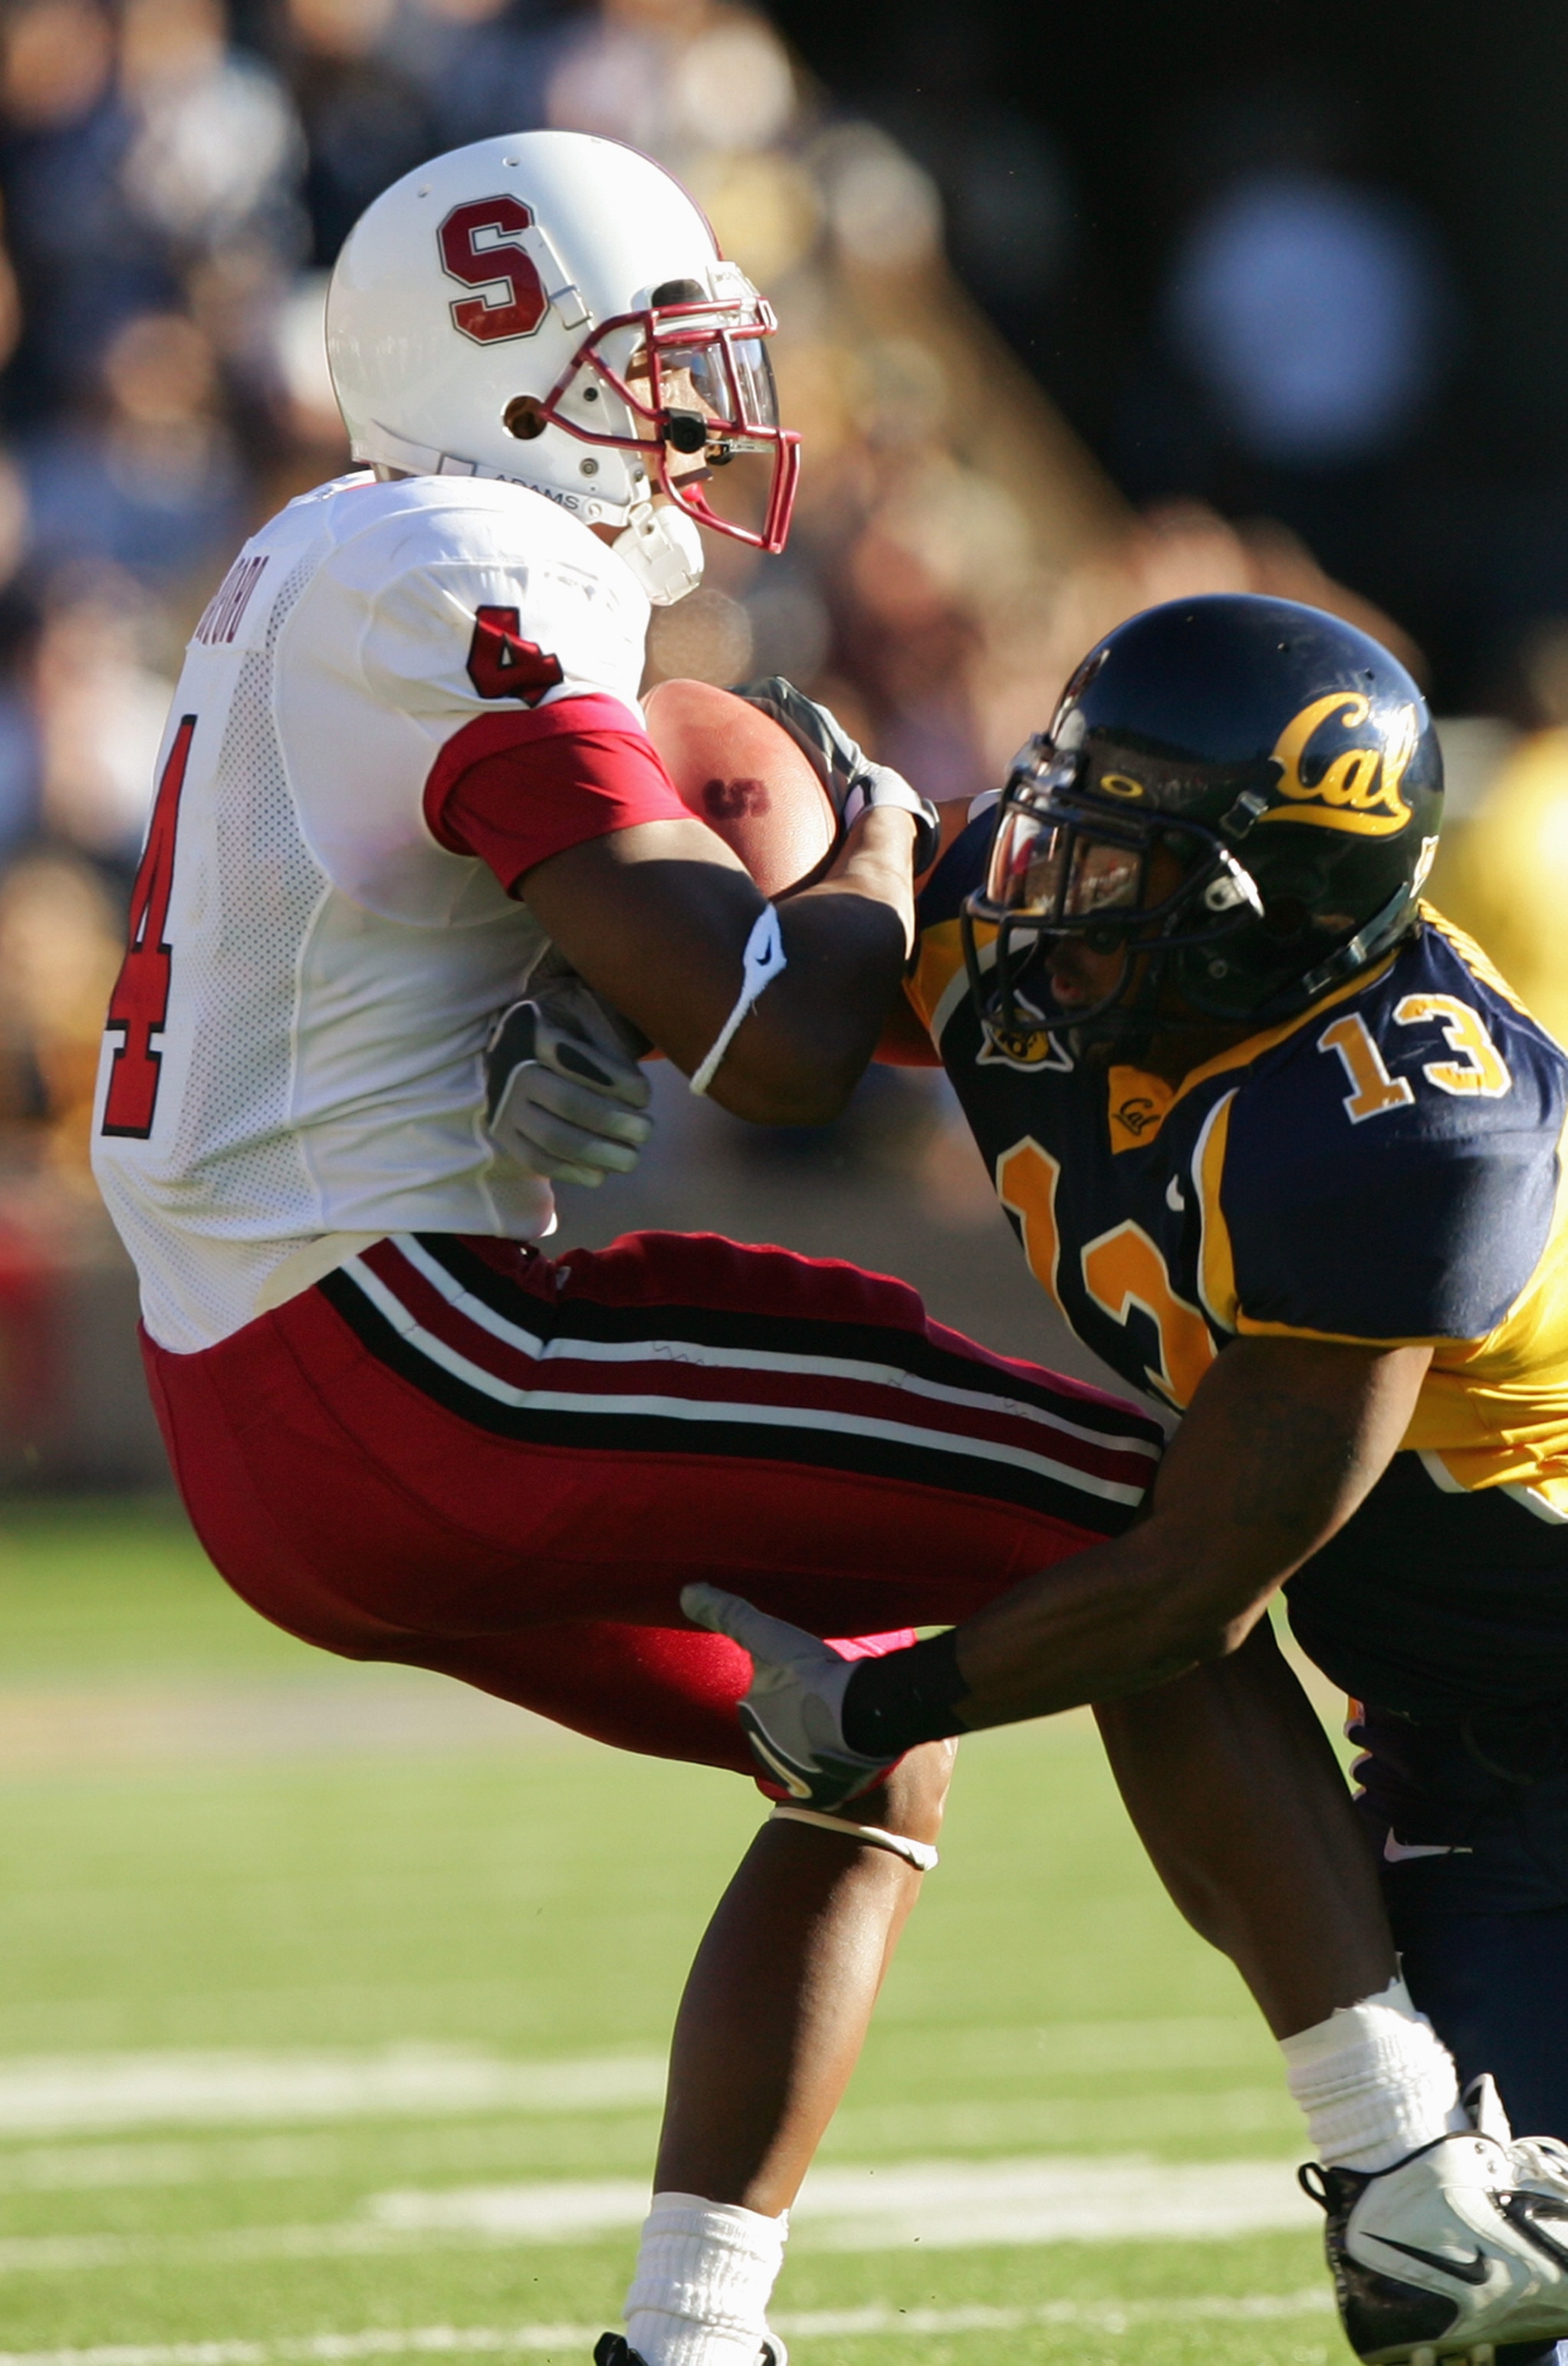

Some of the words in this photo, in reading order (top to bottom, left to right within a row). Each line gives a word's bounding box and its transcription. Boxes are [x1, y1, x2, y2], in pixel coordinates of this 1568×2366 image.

[436, 193, 551, 346] S
[466, 604, 564, 709] 4
[1257, 691, 1417, 837] Cal
[101, 714, 198, 1139] 4
[1112, 1097, 1160, 1137] Cal
[1317, 992, 1514, 1125] 13
